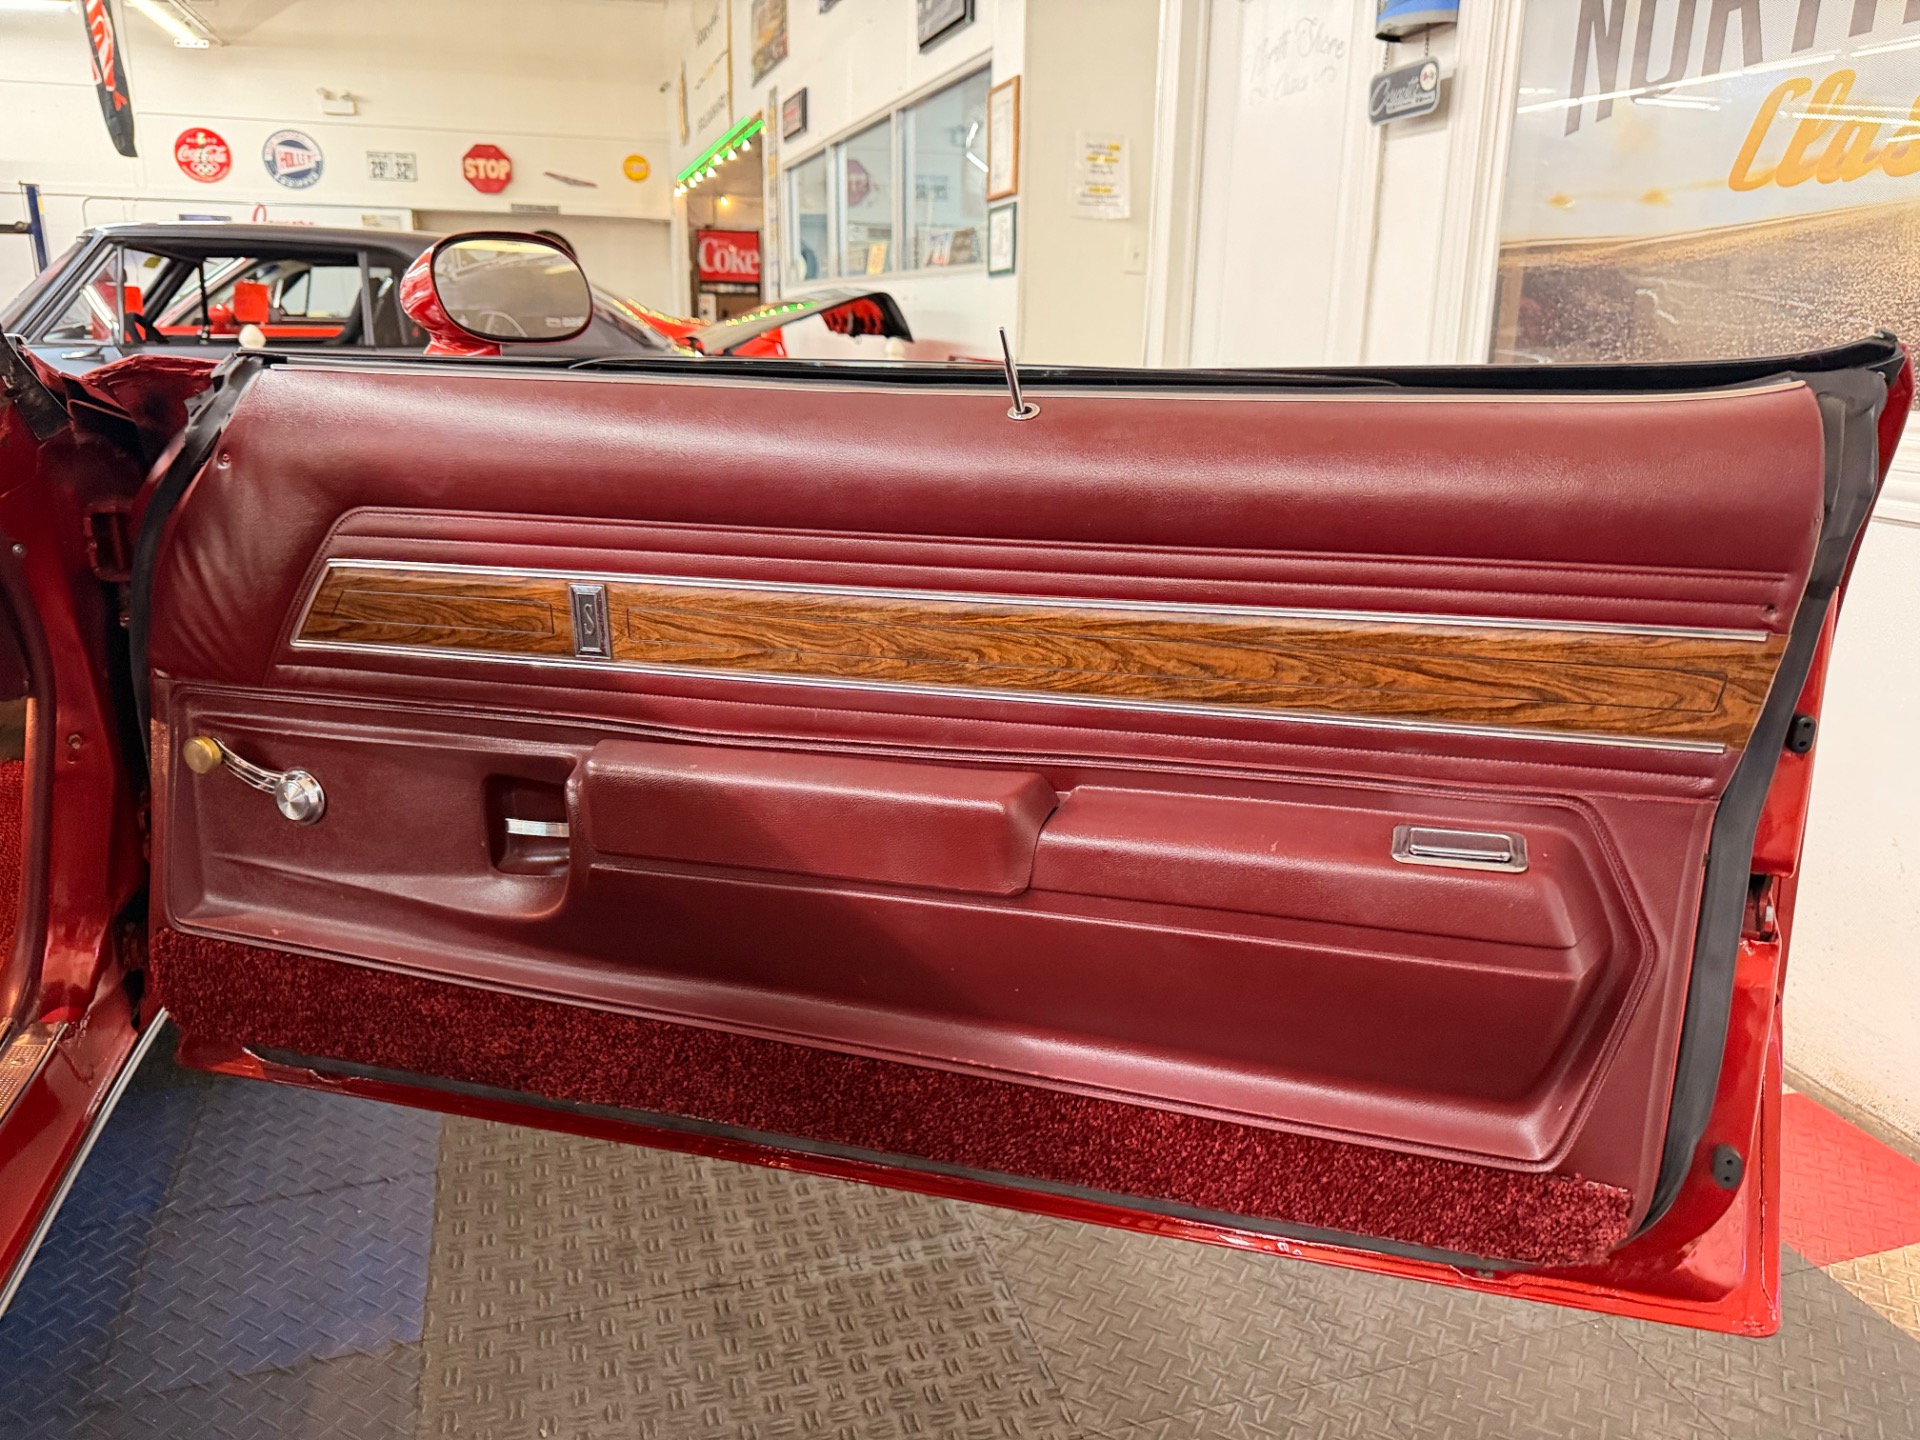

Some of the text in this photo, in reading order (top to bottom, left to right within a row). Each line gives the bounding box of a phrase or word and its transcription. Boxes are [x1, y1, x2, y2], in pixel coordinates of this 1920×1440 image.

[464, 158, 511, 180] STOP
[699, 237, 760, 275] Coke
[583, 603, 595, 636] S
